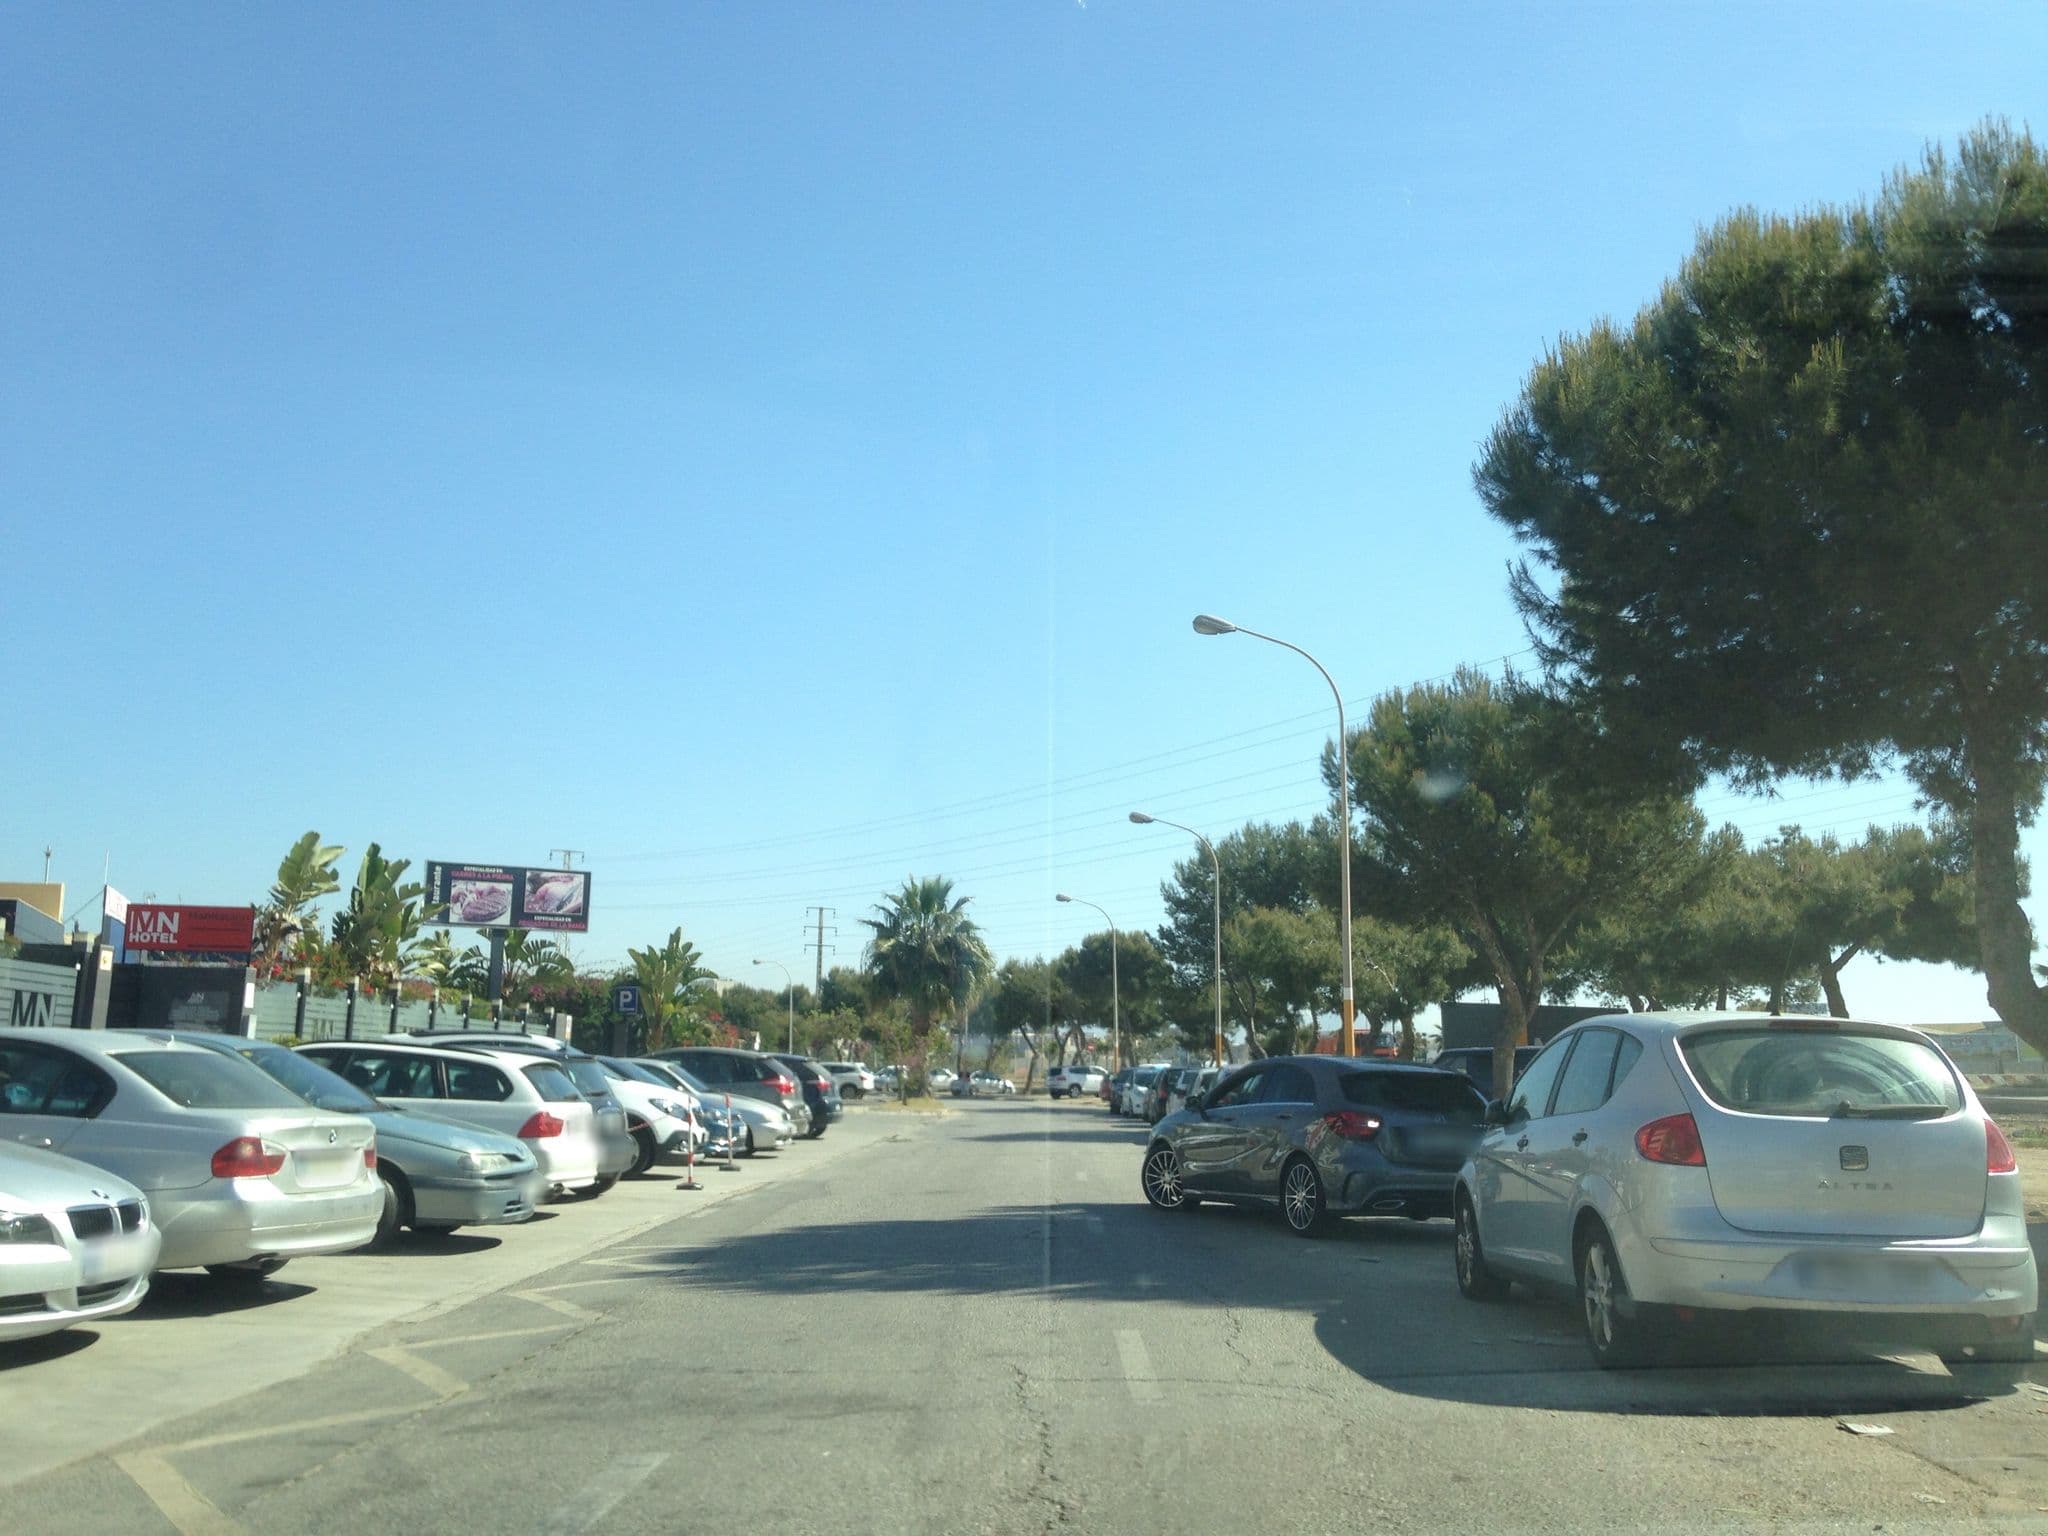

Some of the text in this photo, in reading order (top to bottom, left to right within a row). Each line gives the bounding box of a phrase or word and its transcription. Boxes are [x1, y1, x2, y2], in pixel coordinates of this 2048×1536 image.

[130, 911, 180, 934] MN
[128, 932, 178, 944] HOTEL
[11, 989, 56, 1028] MN
[619, 990, 633, 1009] P
